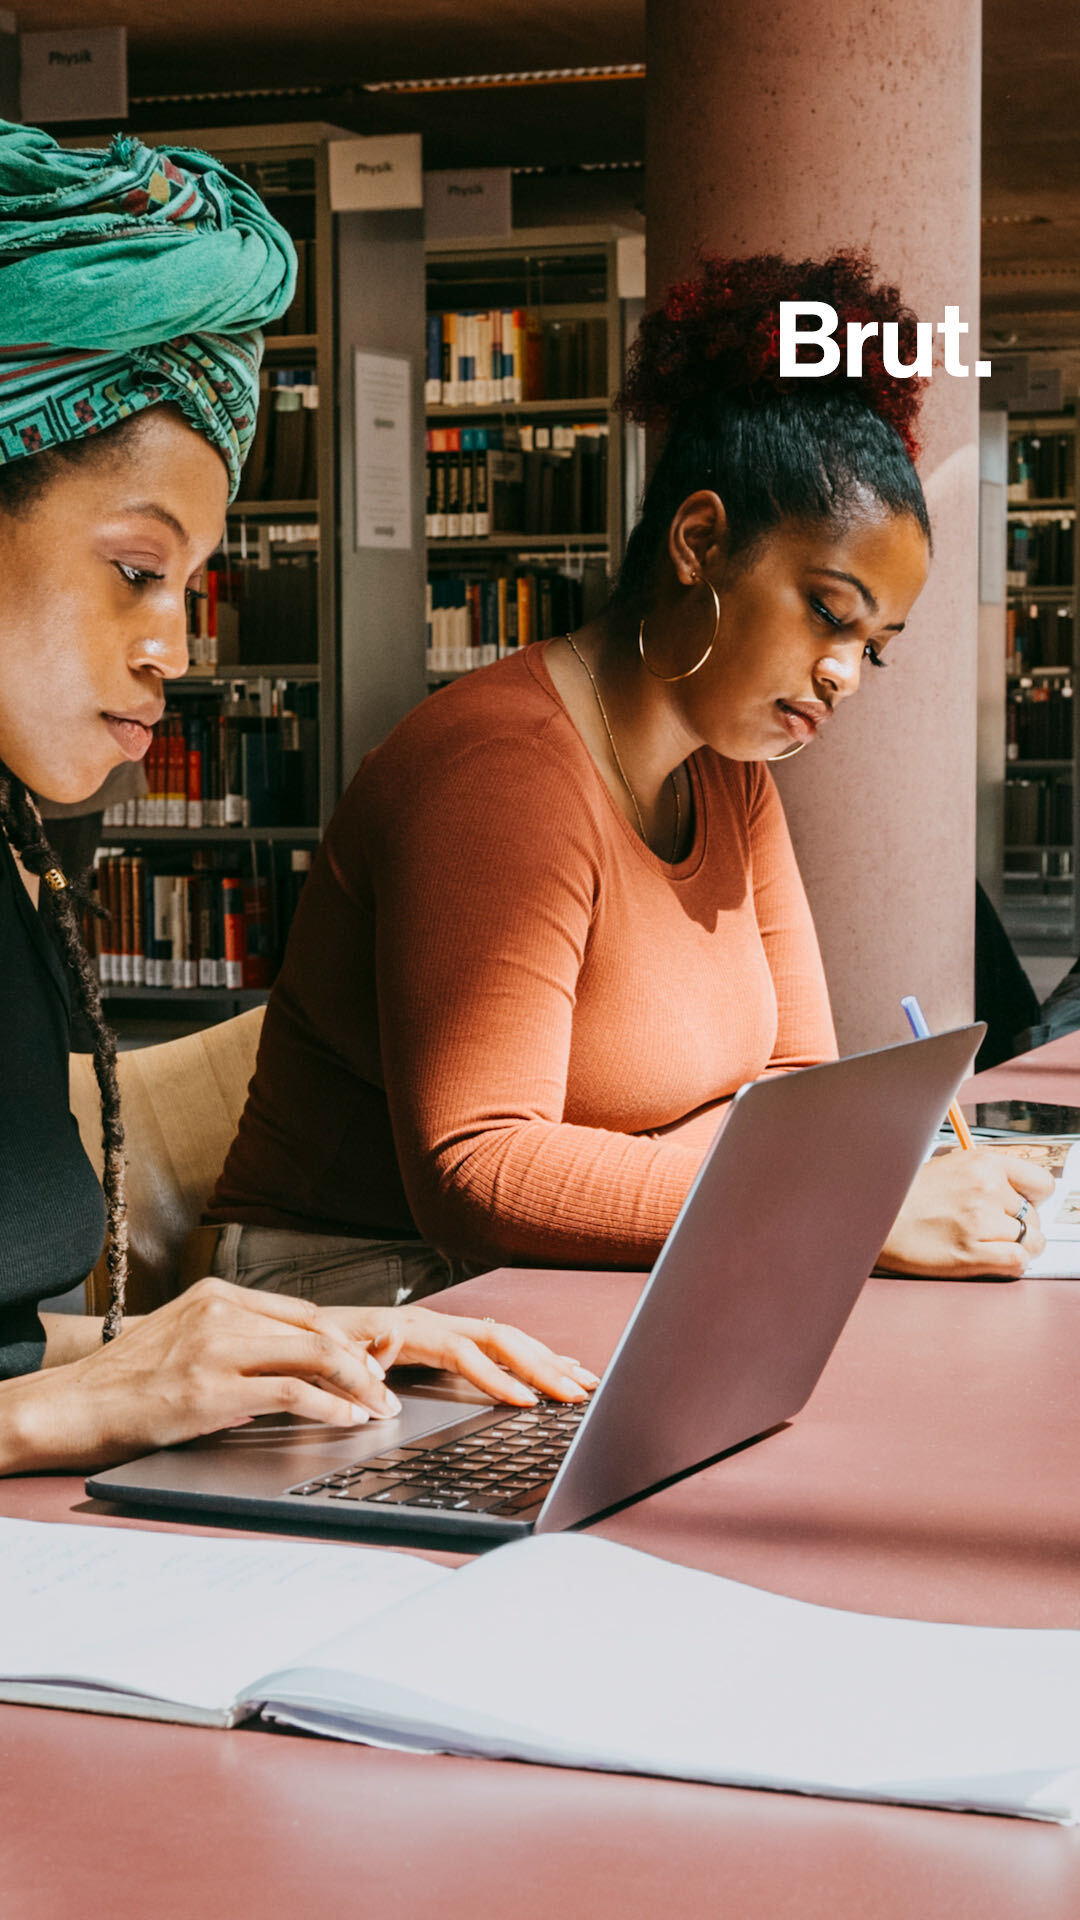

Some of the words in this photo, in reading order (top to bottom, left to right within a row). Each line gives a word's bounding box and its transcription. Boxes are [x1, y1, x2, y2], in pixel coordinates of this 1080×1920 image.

[49, 50, 92, 66] Physik
[355, 162, 392, 176] Physik
[447, 184, 484, 197] Physik
